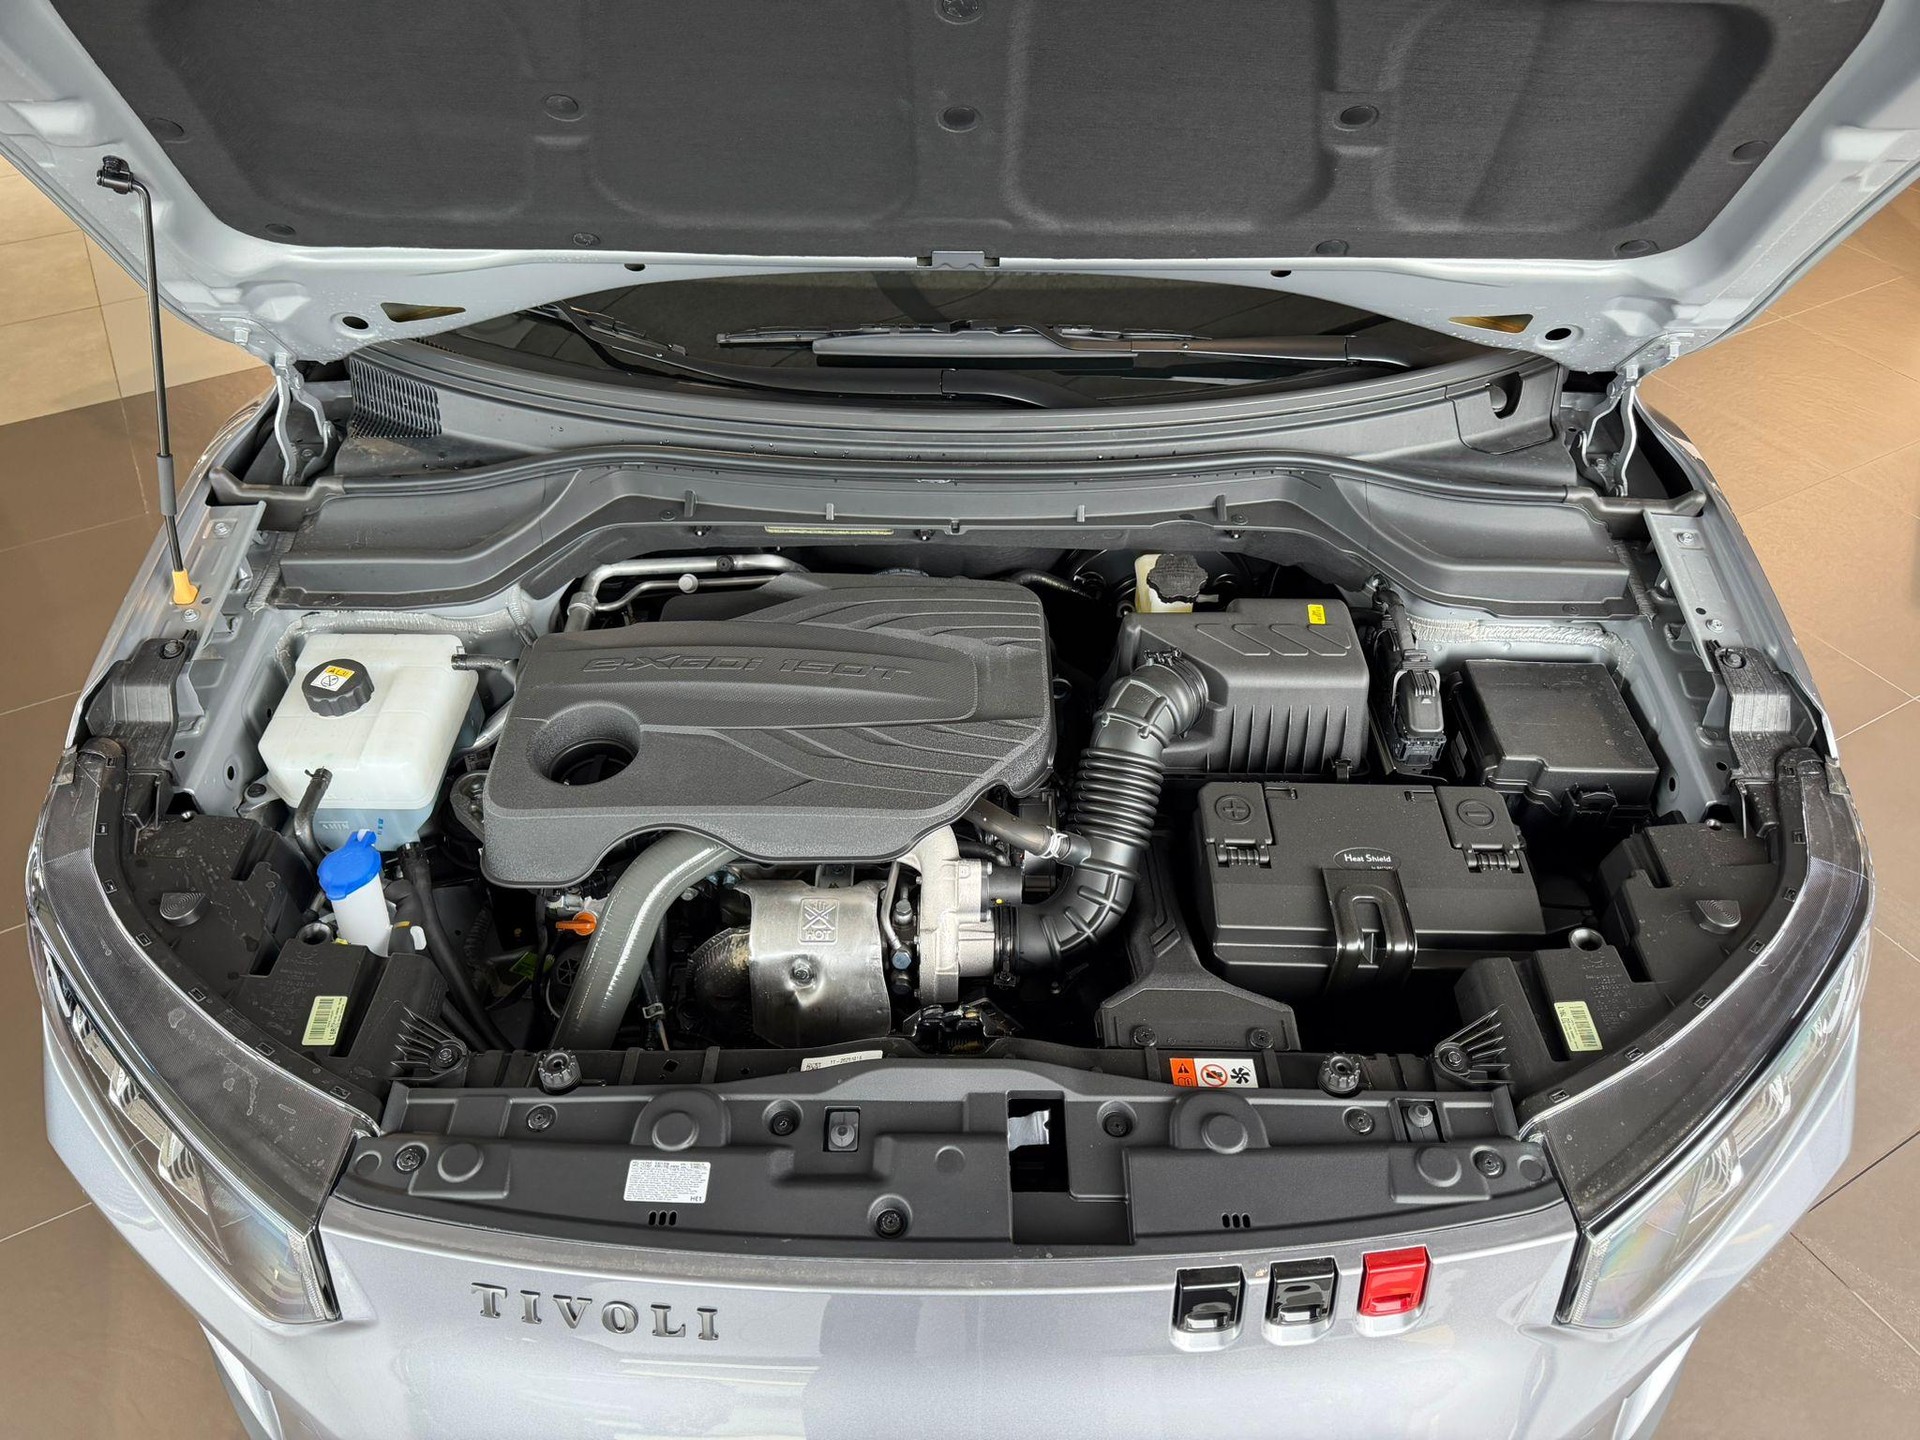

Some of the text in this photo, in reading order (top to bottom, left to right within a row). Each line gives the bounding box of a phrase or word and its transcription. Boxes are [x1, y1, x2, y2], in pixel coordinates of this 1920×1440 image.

[1344, 853, 1392, 862] Heat Shield
[805, 929, 832, 940] HOT
[470, 1282, 719, 1341] TIVOLI
